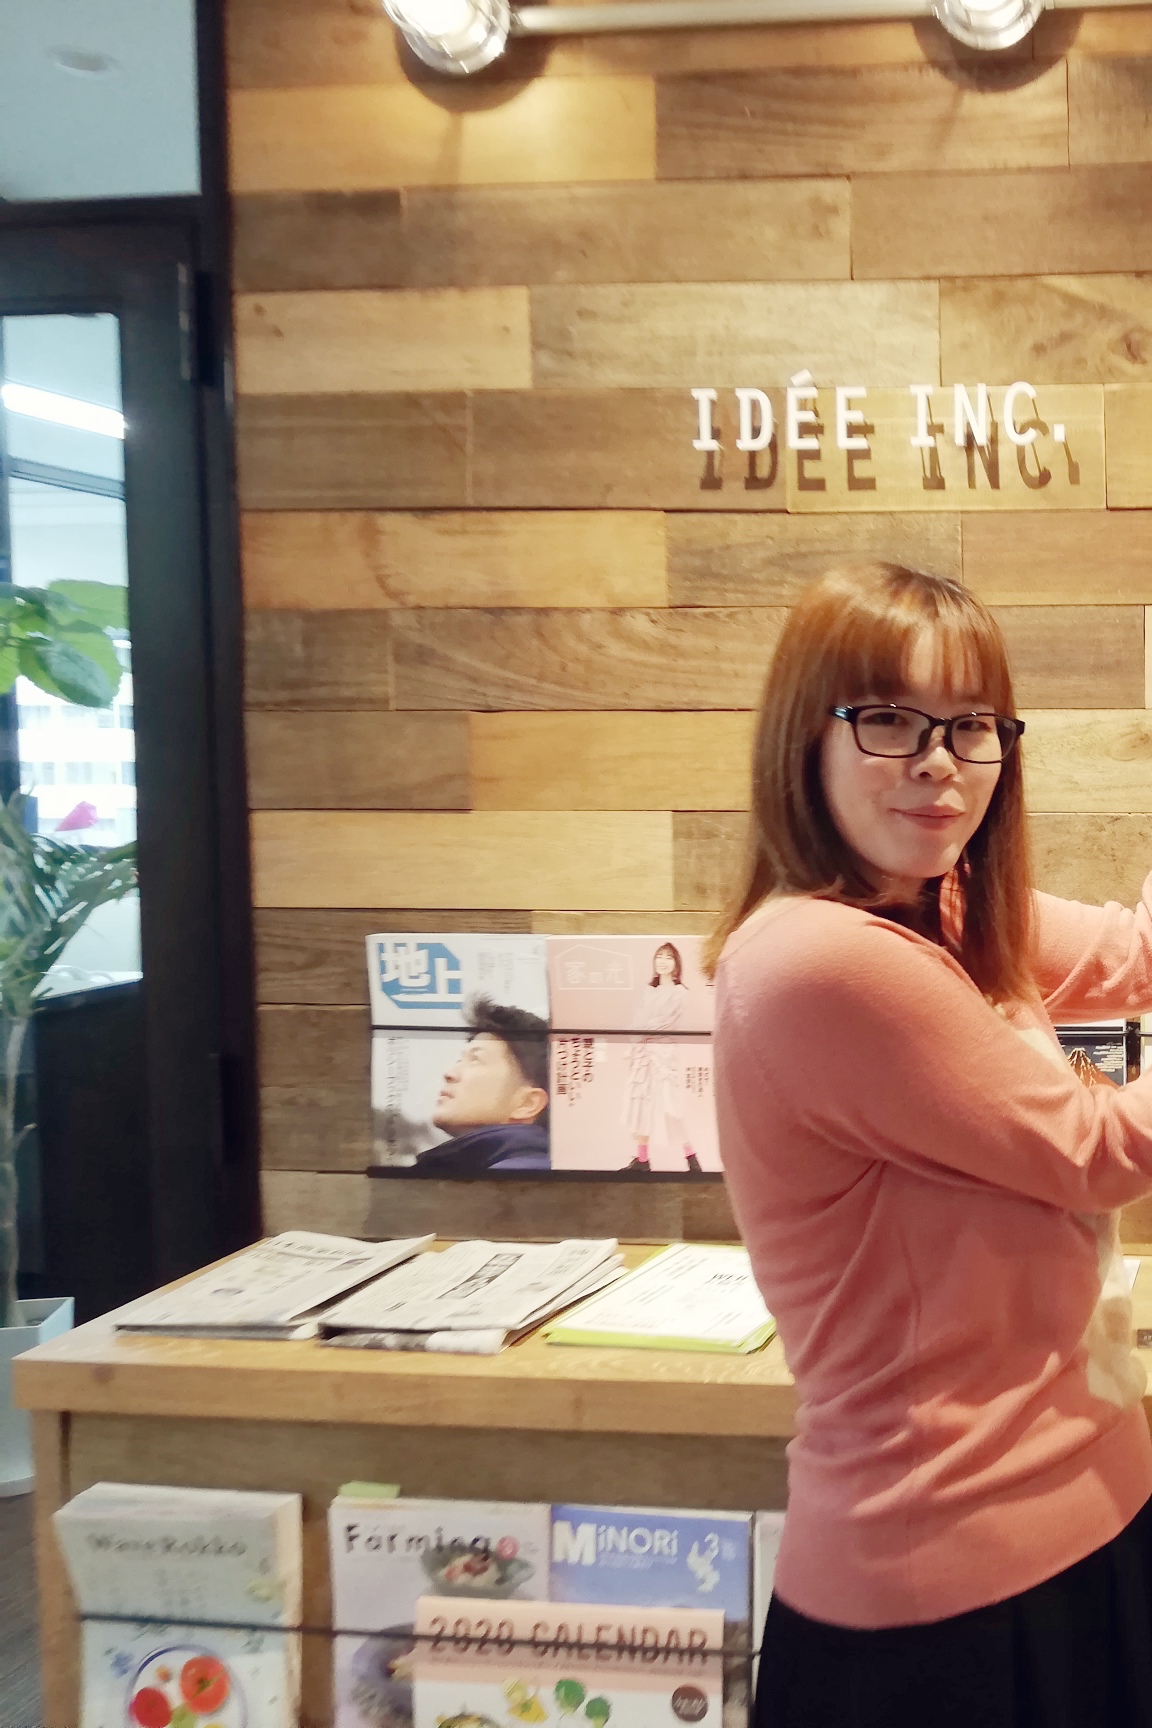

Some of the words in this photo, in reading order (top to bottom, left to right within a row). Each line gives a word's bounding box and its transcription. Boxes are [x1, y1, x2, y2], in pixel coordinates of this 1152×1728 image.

[690, 368, 868, 452] IDÉE
[908, 380, 1066, 448] INC.
[379, 942, 465, 1006] 地上
[428, 1614, 520, 1656] 2020
[529, 1618, 710, 1667] CALENDAR
